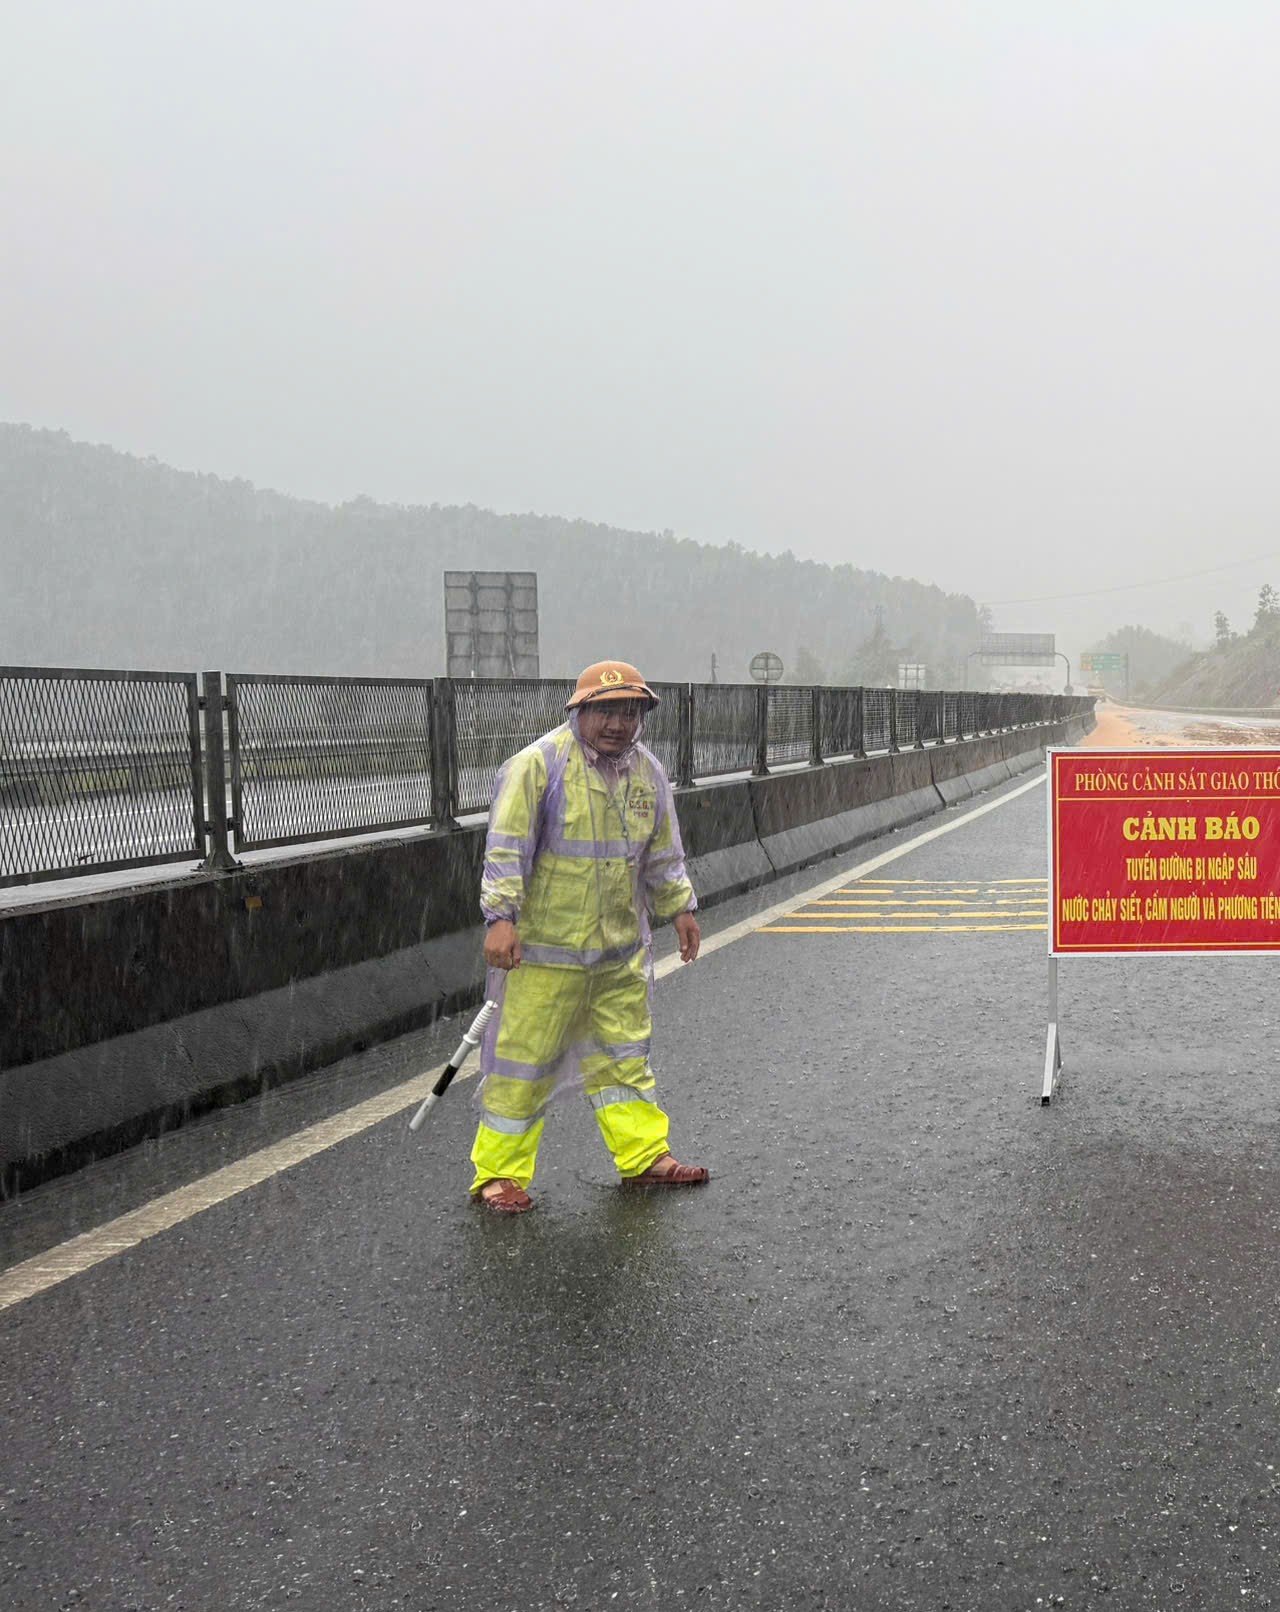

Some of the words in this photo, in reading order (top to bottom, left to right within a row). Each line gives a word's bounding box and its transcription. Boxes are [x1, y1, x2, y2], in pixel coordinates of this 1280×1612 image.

[1075, 767, 1128, 791] PHÒNG
[1132, 767, 1175, 790] CẢNH
[1179, 766, 1207, 790] SÁT
[1211, 771, 1249, 789] GIAO
[1123, 811, 1197, 840] CẢNH
[1205, 811, 1260, 840] BÁO
[1126, 851, 1157, 881] TUYẾN
[1160, 852, 1193, 881] ĐƯỜNG
[1196, 857, 1206, 885] BỊ
[1208, 852, 1234, 884] NGẬP
[1238, 852, 1257, 879] SÂU
[1063, 894, 1089, 921] NƯỚC
[1092, 891, 1117, 920] CHẢY
[1120, 891, 1143, 922] SIẾT,
[1146, 891, 1168, 920] CẤM
[1171, 892, 1200, 920] NGƯỜI
[1202, 892, 1215, 920] VÀ
[1218, 896, 1258, 919] PHƯƠNG
